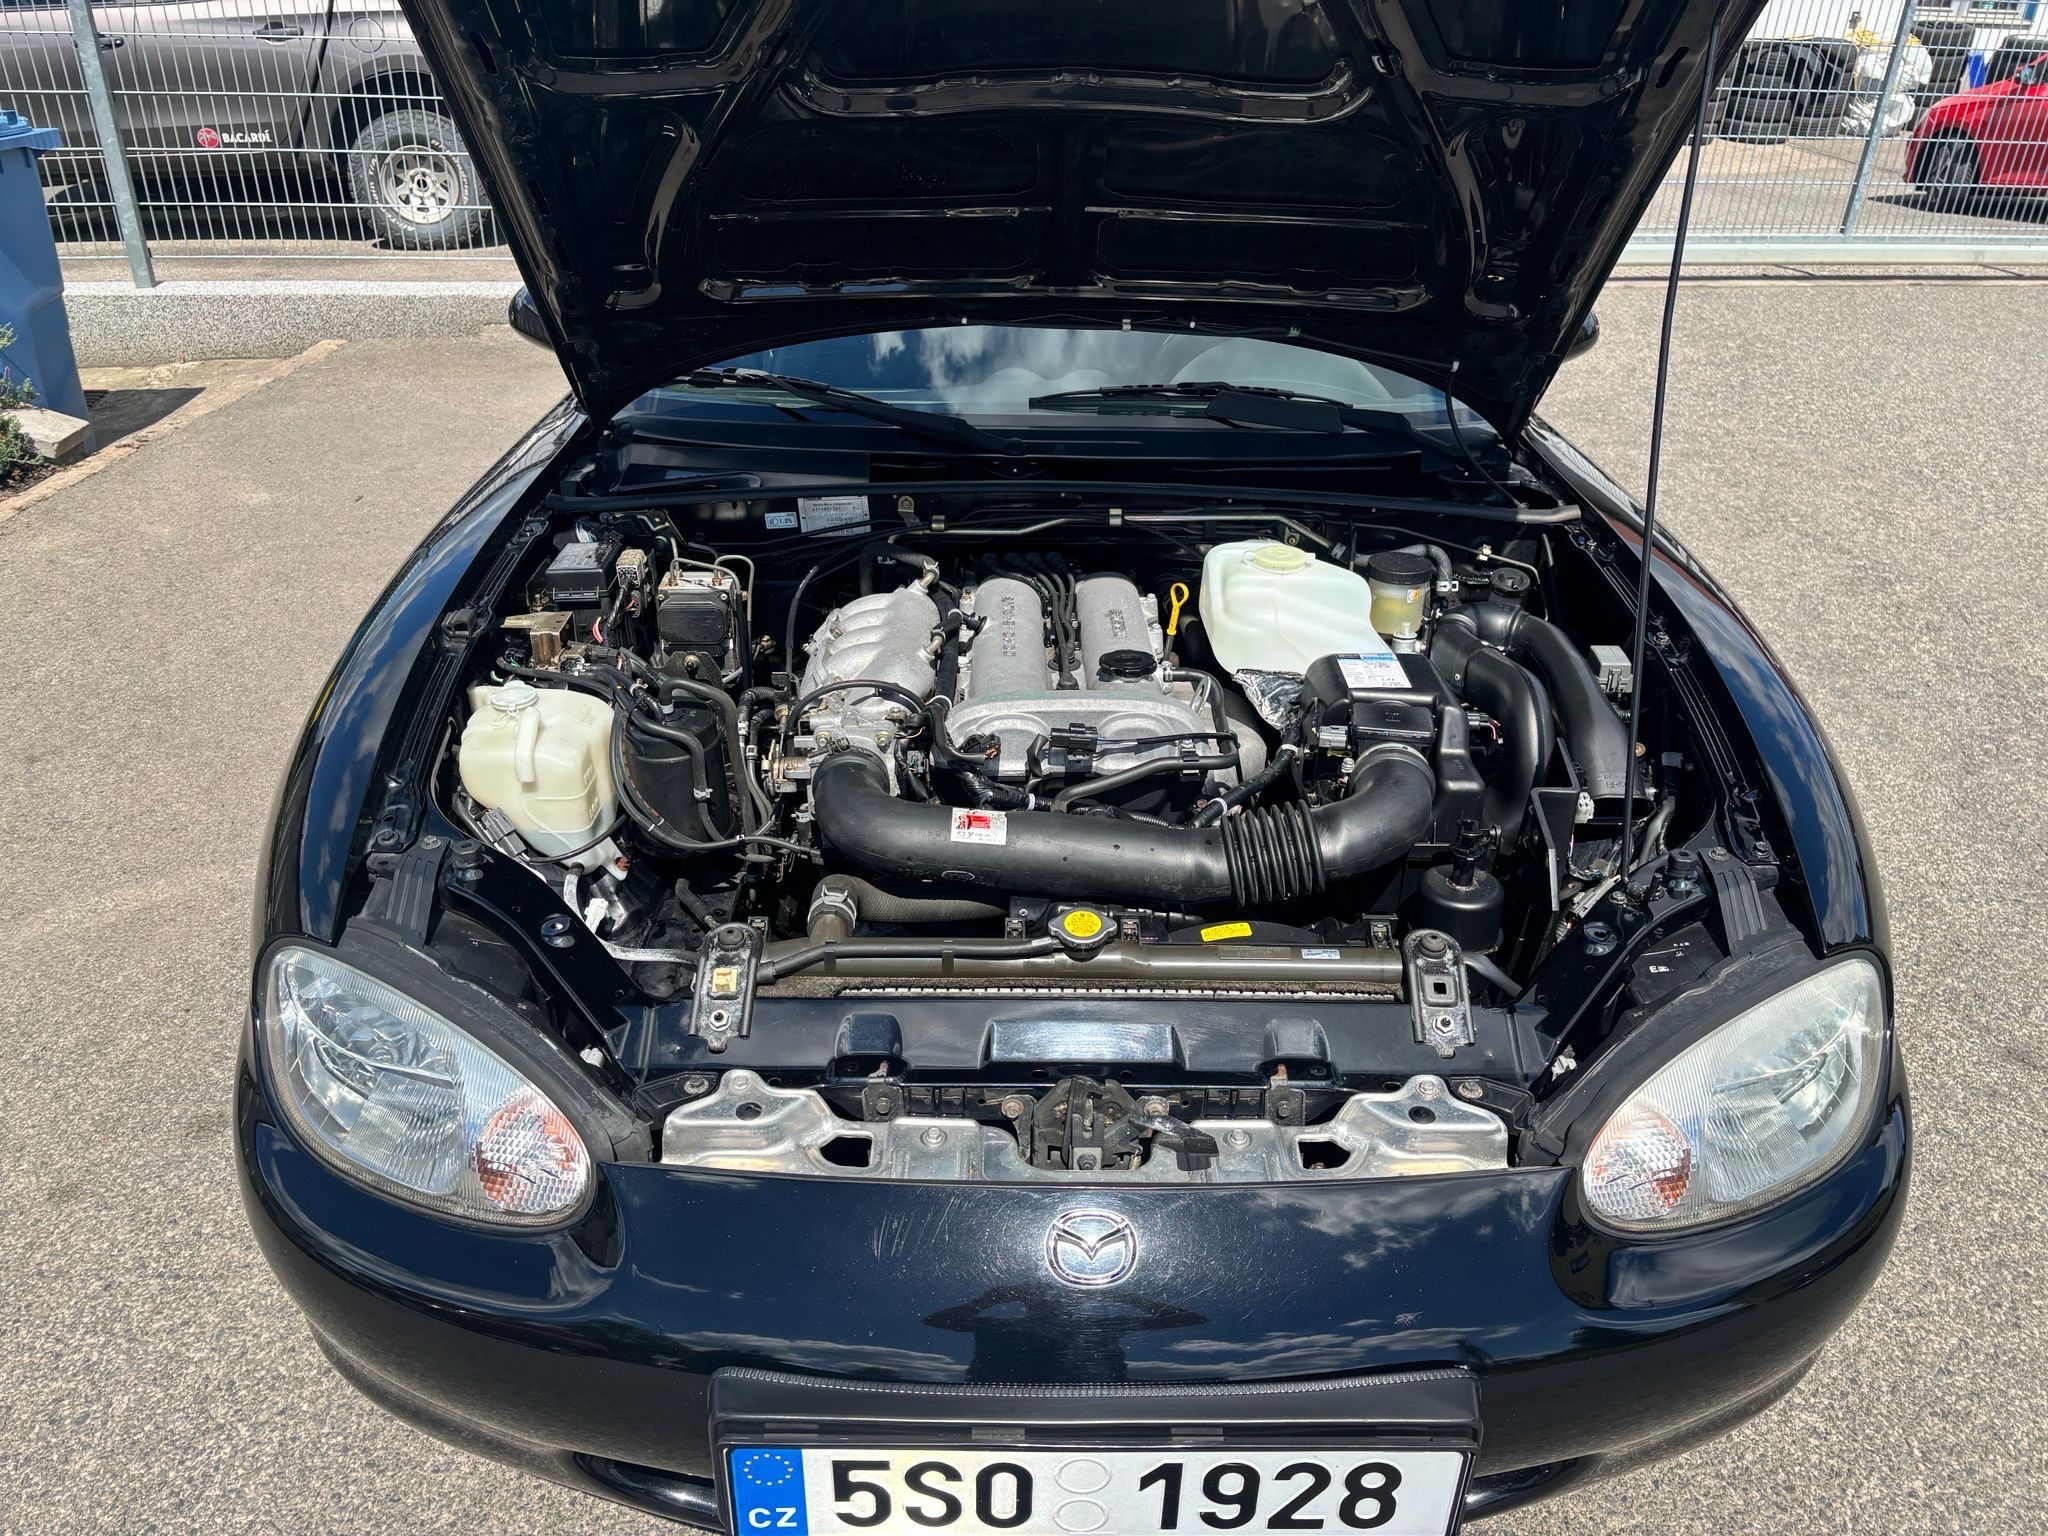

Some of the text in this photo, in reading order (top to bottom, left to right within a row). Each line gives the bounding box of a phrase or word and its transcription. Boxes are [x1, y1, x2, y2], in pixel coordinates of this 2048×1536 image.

[221, 129, 273, 143] BACARDÍ
[1138, 1461, 1403, 1530] 1928
[748, 1506, 798, 1529] CZ
